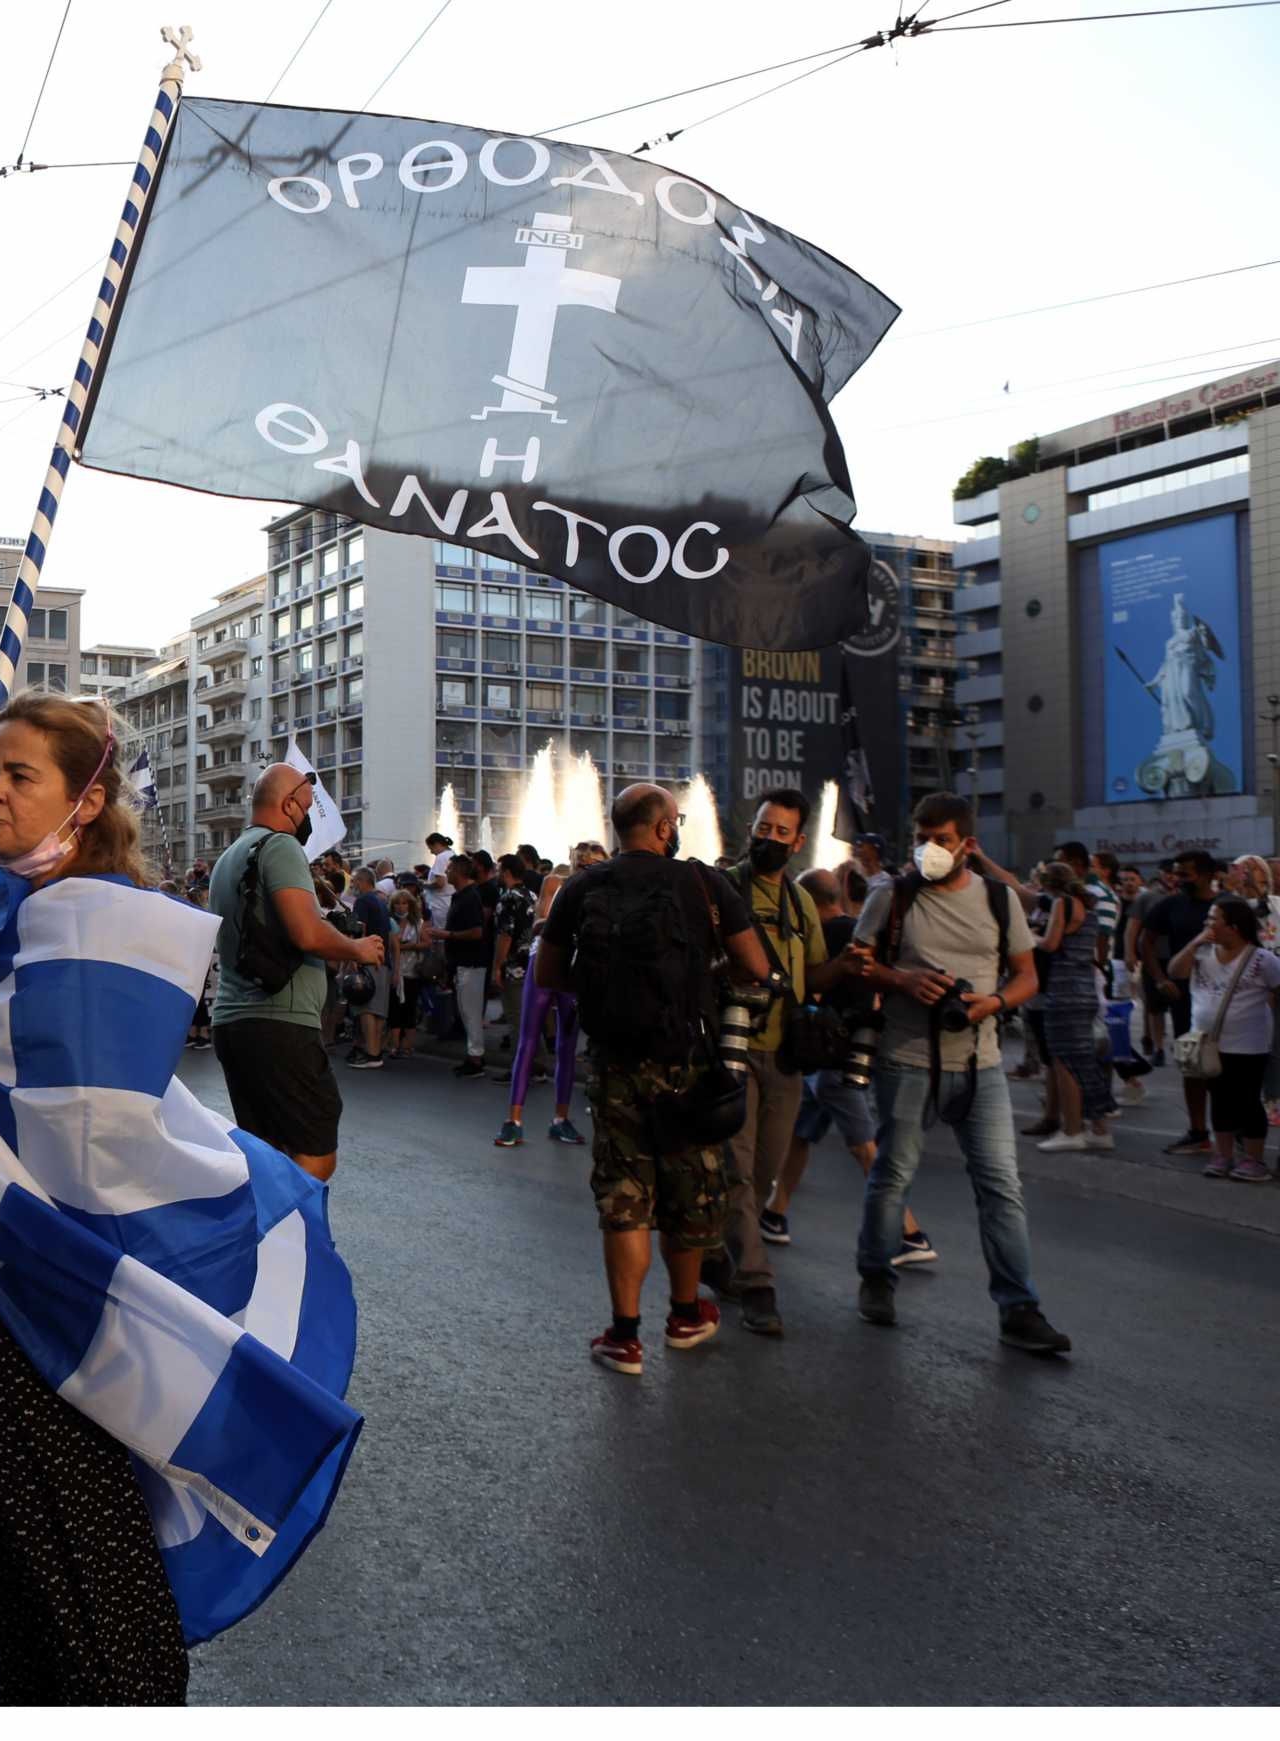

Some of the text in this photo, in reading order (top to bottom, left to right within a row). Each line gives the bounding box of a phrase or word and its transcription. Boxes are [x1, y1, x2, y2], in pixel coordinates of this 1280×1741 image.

[1198, 369, 1279, 405] Center
[742, 649, 820, 683] BROWN
[742, 686, 839, 723] IS ABOUT
[743, 727, 804, 762] TO BE
